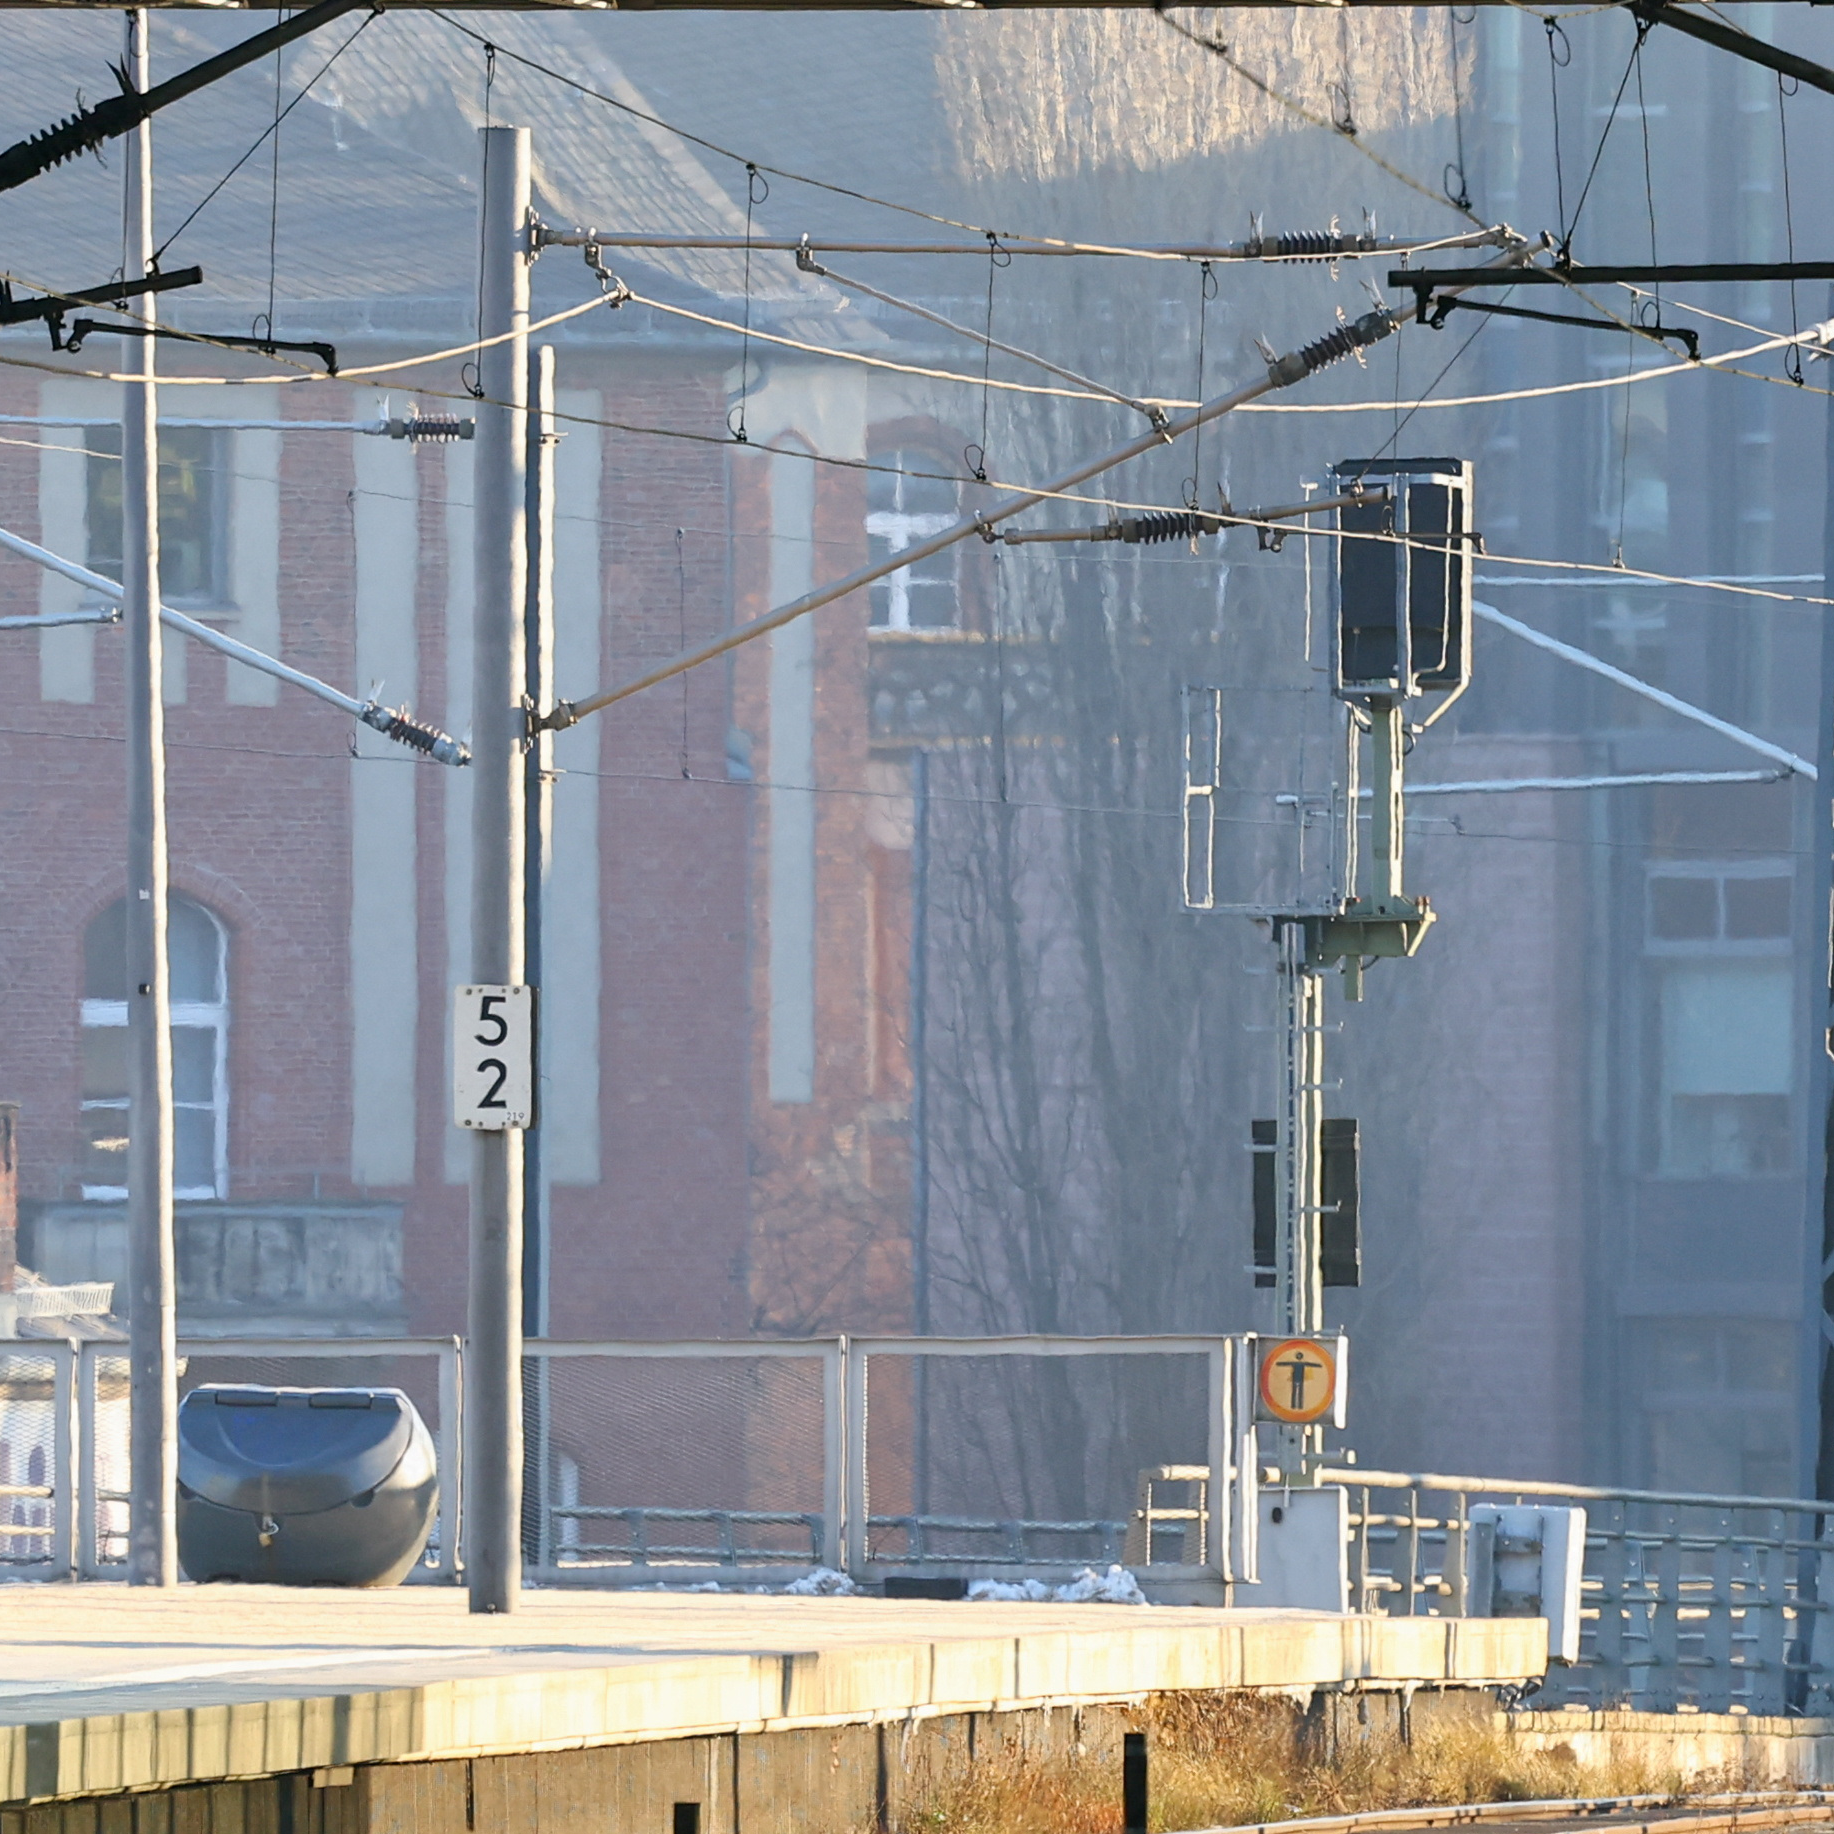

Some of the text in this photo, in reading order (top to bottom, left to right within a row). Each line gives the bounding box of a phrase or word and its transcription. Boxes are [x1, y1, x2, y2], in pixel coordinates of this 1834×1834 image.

[473, 995, 508, 1047] 5
[476, 1057, 507, 1109] 2
[507, 1112, 525, 1121] 219
